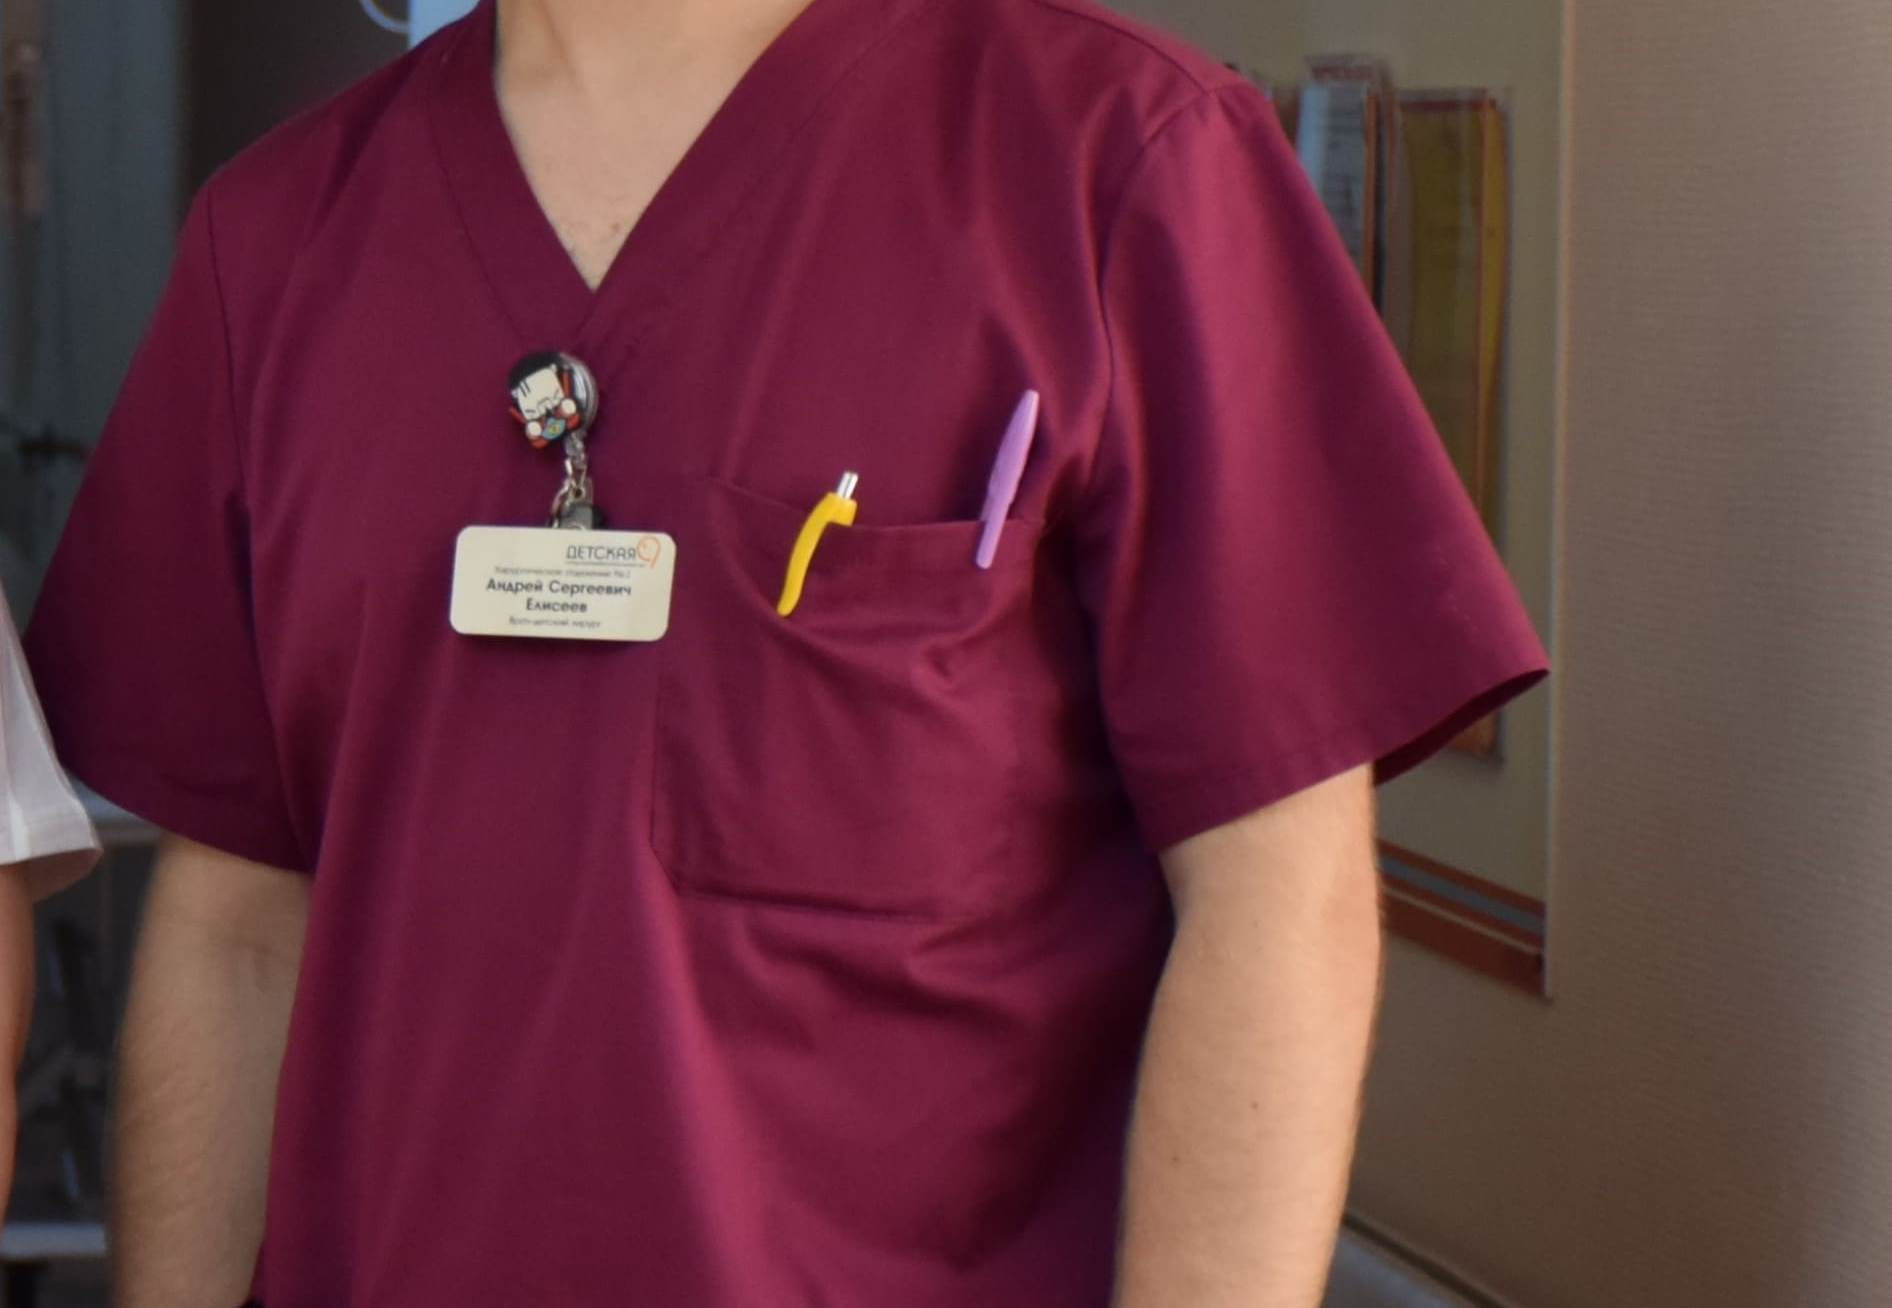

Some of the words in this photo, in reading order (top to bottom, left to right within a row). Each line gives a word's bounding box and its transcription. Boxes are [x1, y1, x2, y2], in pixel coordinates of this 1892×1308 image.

[566, 545, 636, 561] ДЕТСКАЯ
[486, 577, 543, 594] Андрей
[549, 580, 632, 597] Сергеевич
[526, 597, 588, 613] Елисеев
